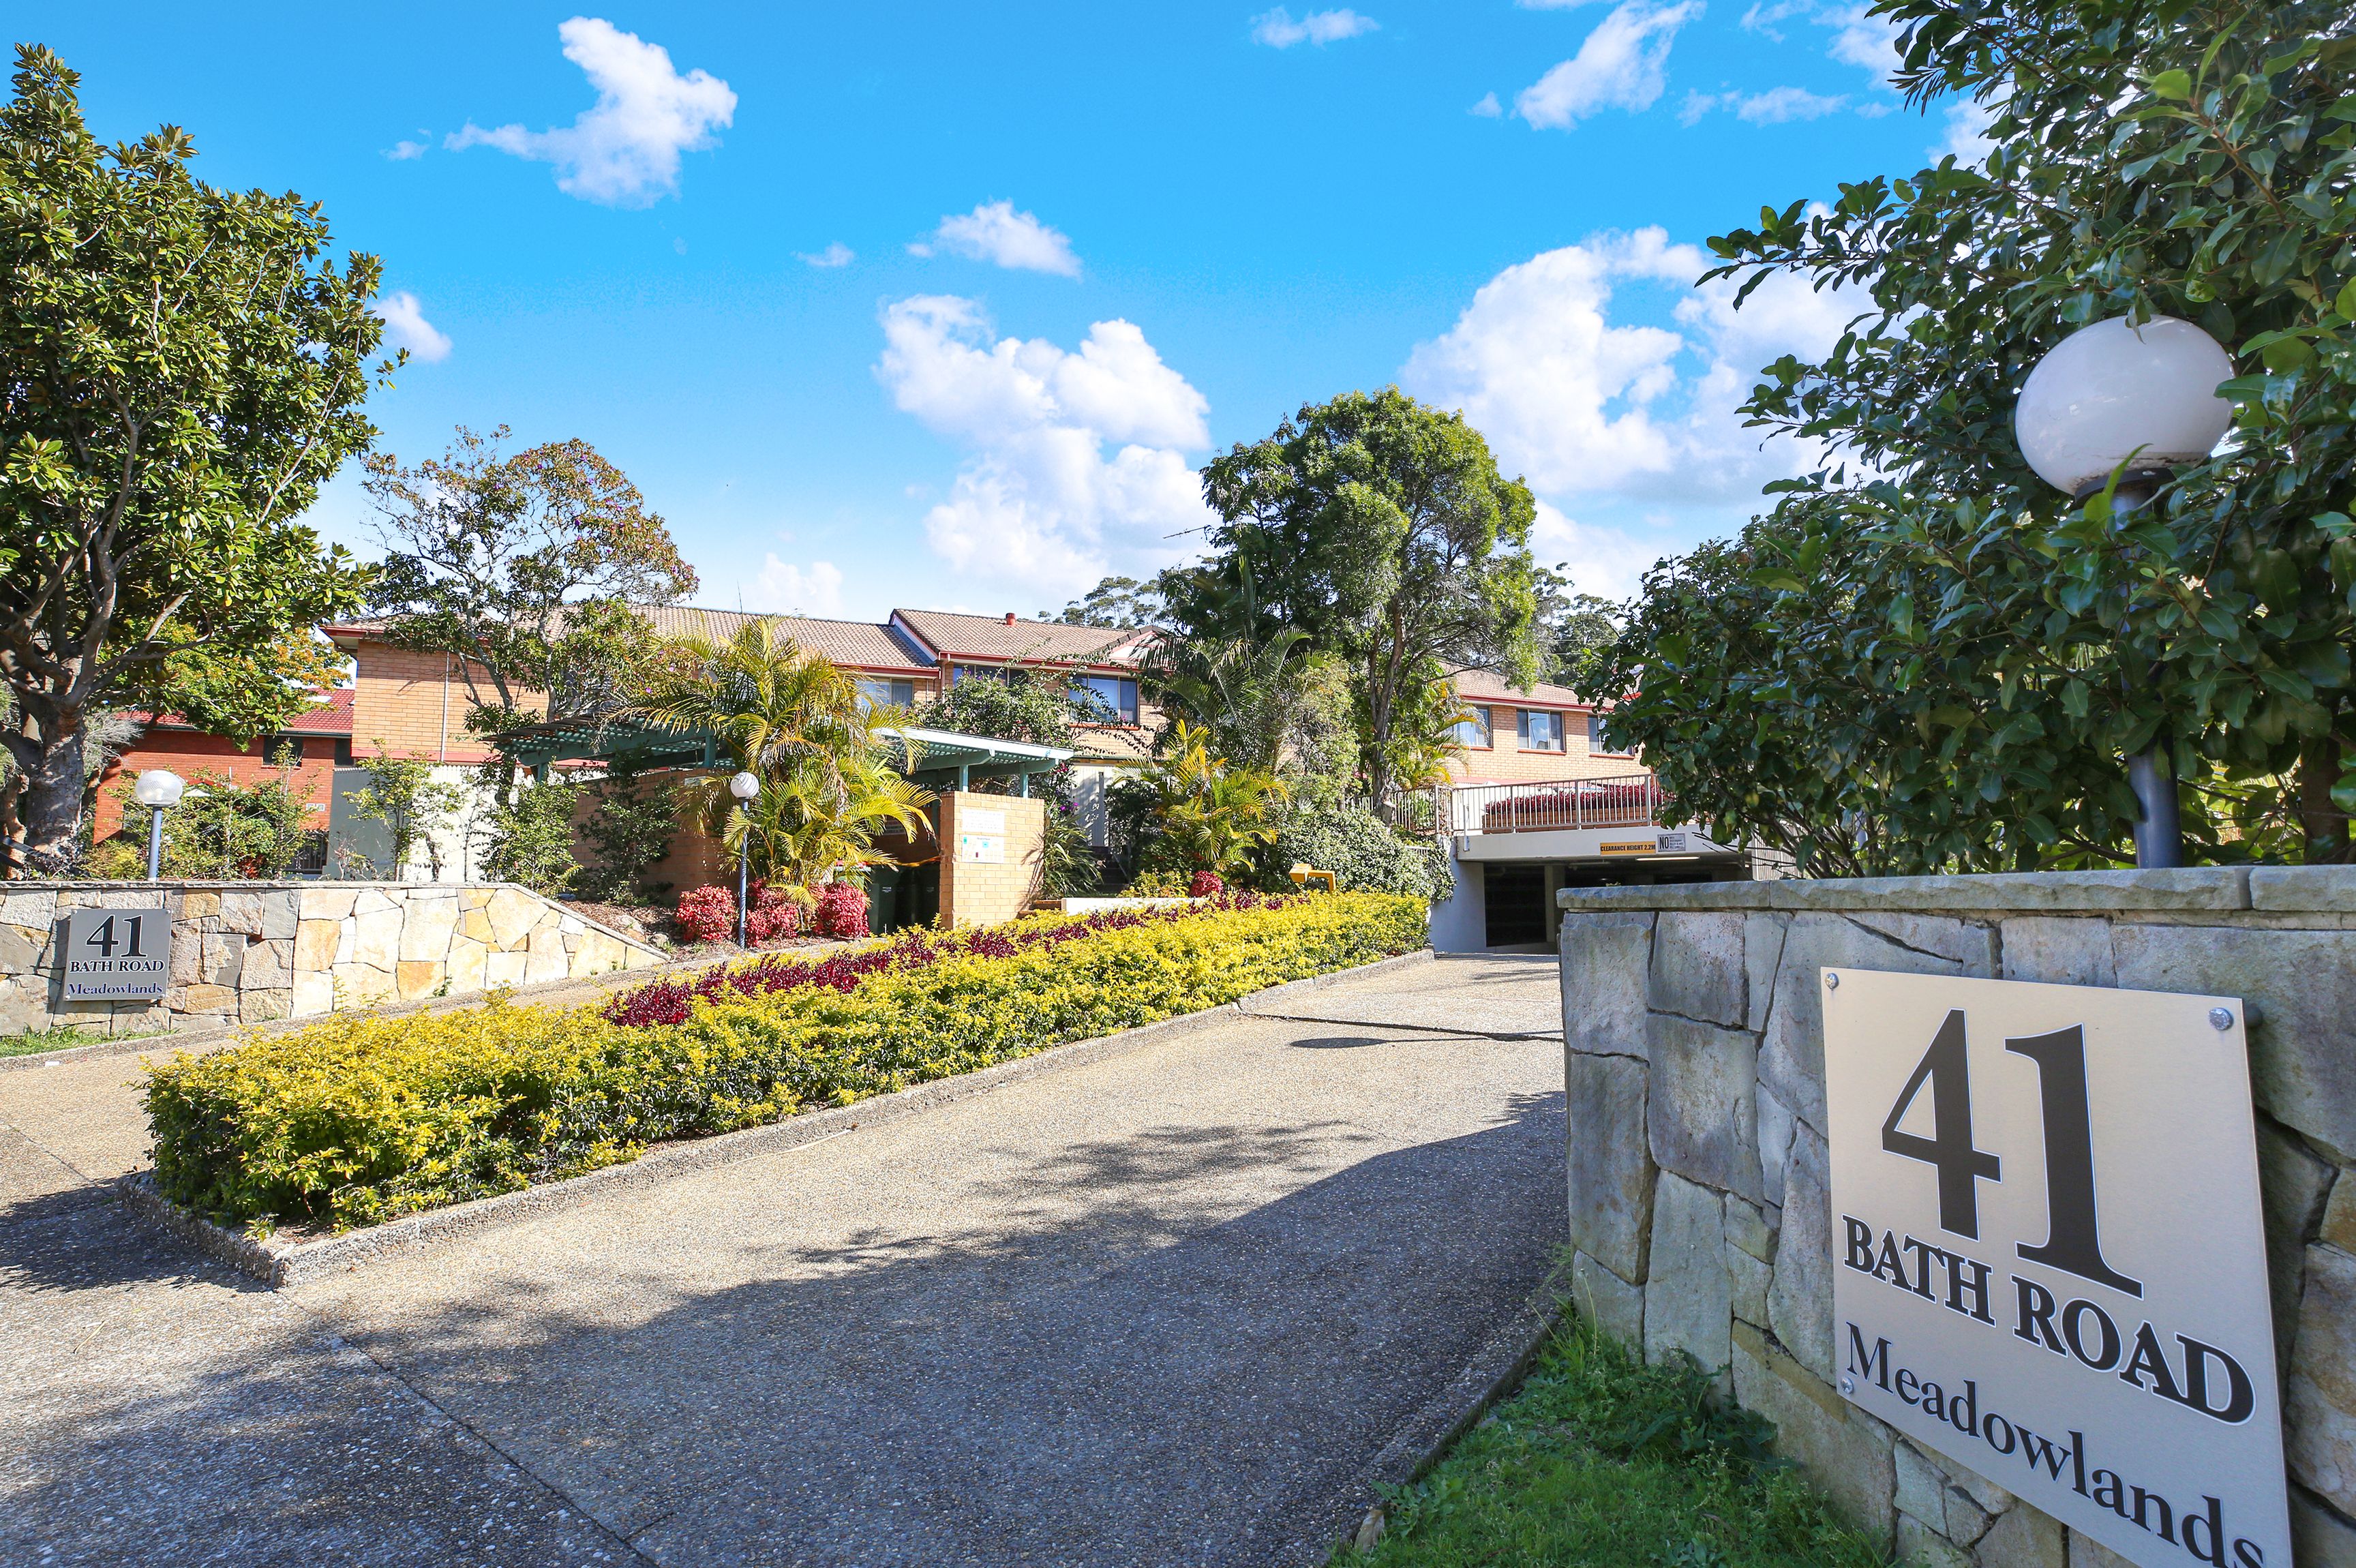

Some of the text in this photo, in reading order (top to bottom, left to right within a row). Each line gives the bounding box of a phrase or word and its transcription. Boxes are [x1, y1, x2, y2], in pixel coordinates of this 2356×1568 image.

[1659, 836, 1670, 849] NO
[86, 915, 148, 958] 41
[70, 960, 165, 973] BATH ROAD
[67, 982, 163, 995] Meadowlands
[1881, 1008, 2145, 1299] 41
[1841, 1213, 2257, 1426] BATH ROAD
